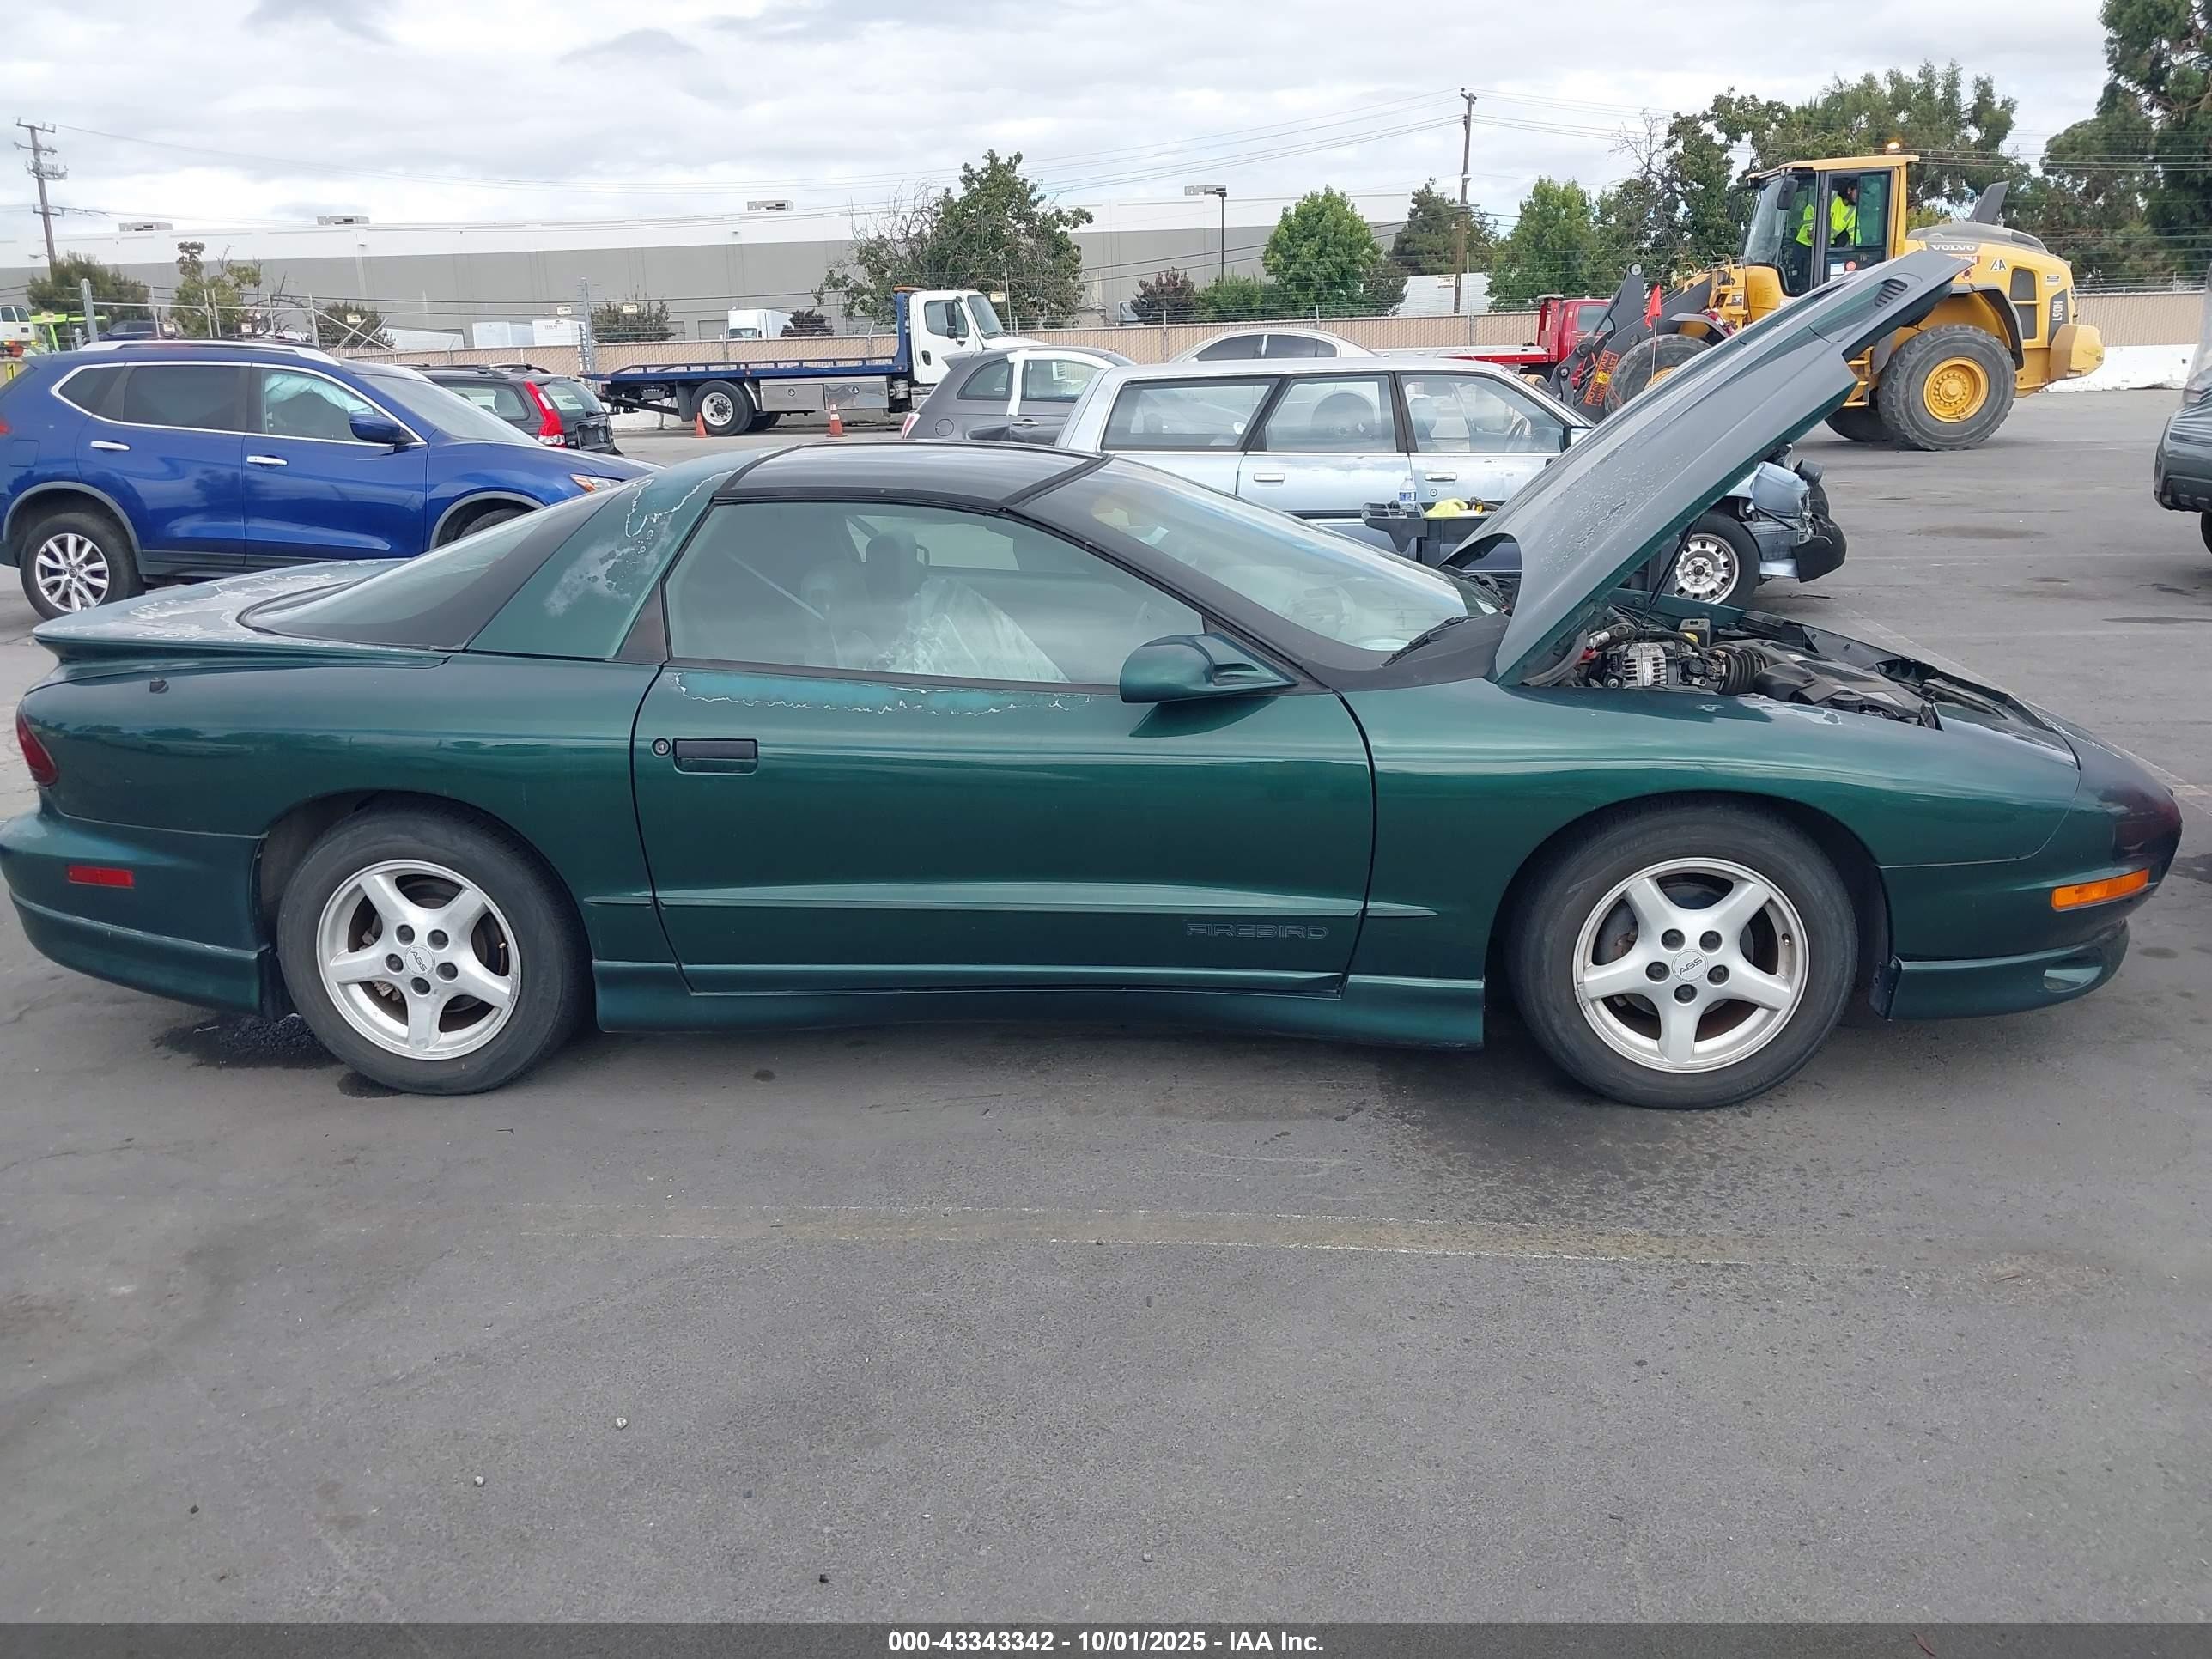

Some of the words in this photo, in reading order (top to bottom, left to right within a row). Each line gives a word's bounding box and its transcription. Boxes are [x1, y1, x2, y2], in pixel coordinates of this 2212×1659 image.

[2052, 301, 2063, 321] L90H
[9, 363, 14, 379] 1
[1187, 923, 1328, 939] FIREBIRD
[410, 951, 428, 972] ABS
[1680, 957, 1703, 975] ABS
